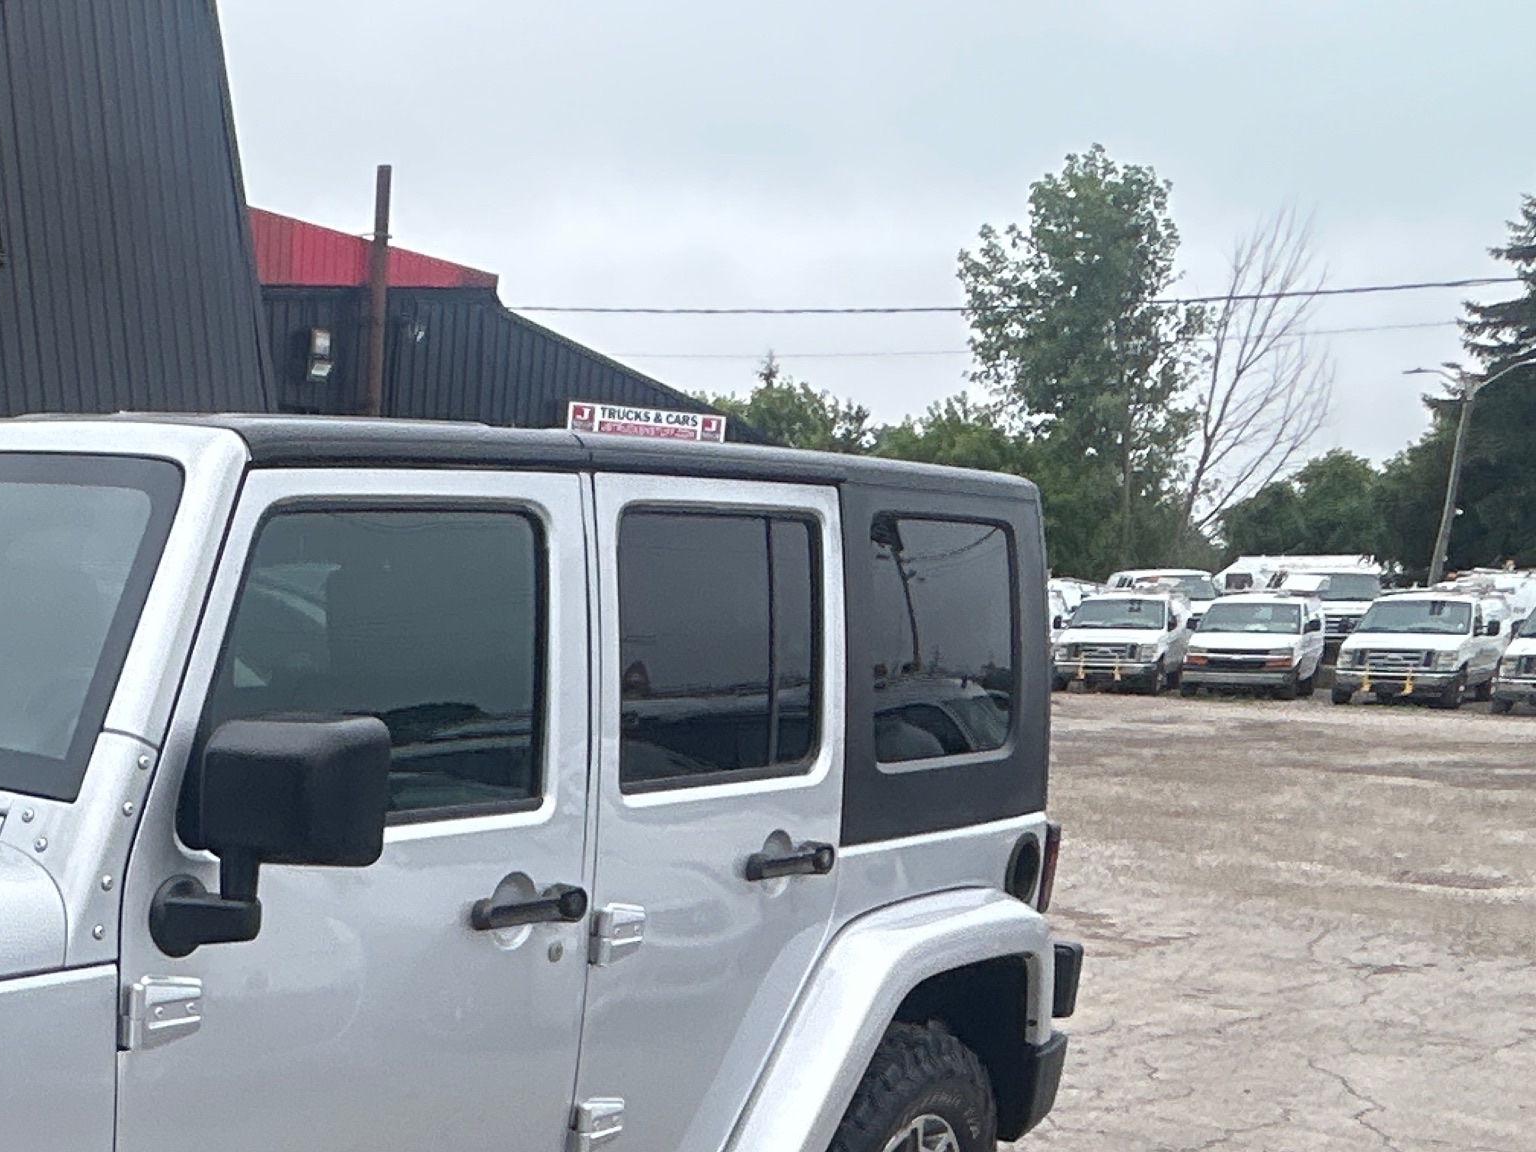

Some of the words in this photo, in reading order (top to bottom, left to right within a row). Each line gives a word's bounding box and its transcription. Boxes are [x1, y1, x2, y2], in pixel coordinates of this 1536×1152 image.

[600, 407, 651, 423] TRUCKS
[653, 412, 664, 424] &
[666, 413, 698, 427] CARS
